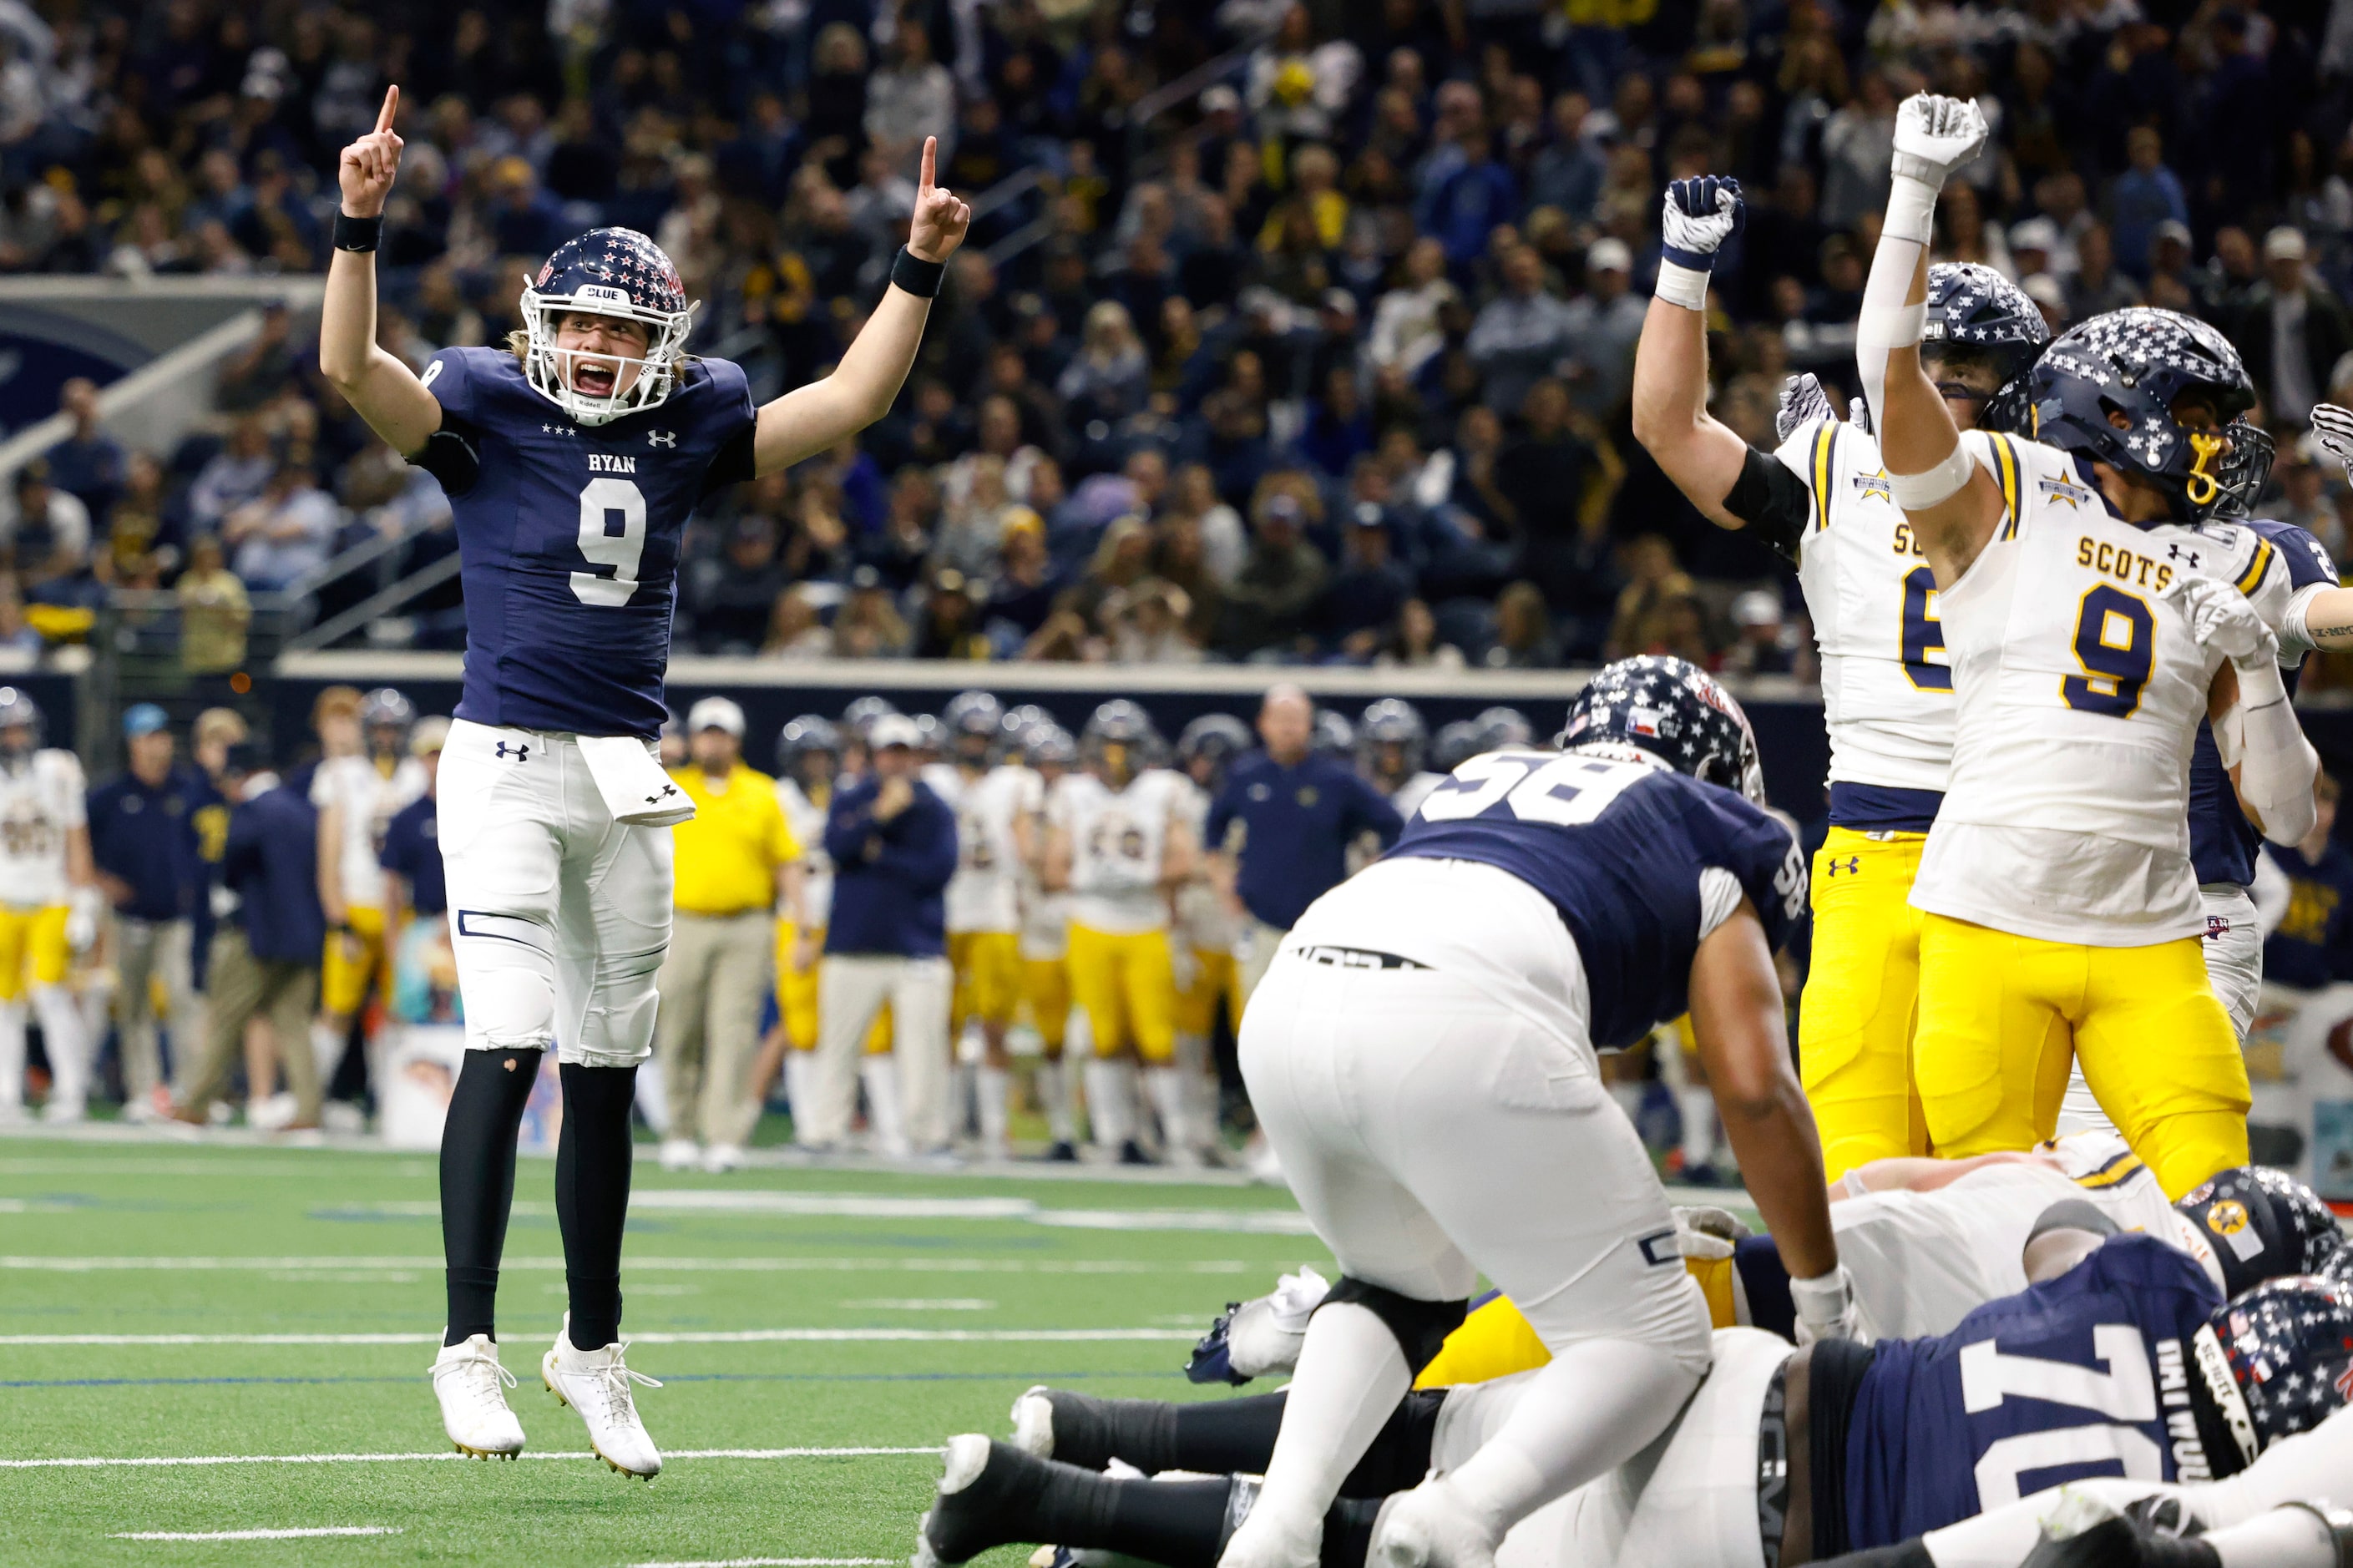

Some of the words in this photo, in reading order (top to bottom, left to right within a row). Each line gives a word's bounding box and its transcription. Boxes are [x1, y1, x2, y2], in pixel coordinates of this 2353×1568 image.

[587, 287, 619, 301] BLUE
[579, 400, 601, 408] Riddell
[588, 453, 635, 473] RYAN
[569, 477, 647, 608] 9
[2077, 534, 2173, 594] SCOTS
[2057, 579, 2158, 721] 9
[1419, 751, 1656, 827] 58
[1774, 839, 1809, 920] 58
[1959, 1323, 2163, 1514] 70
